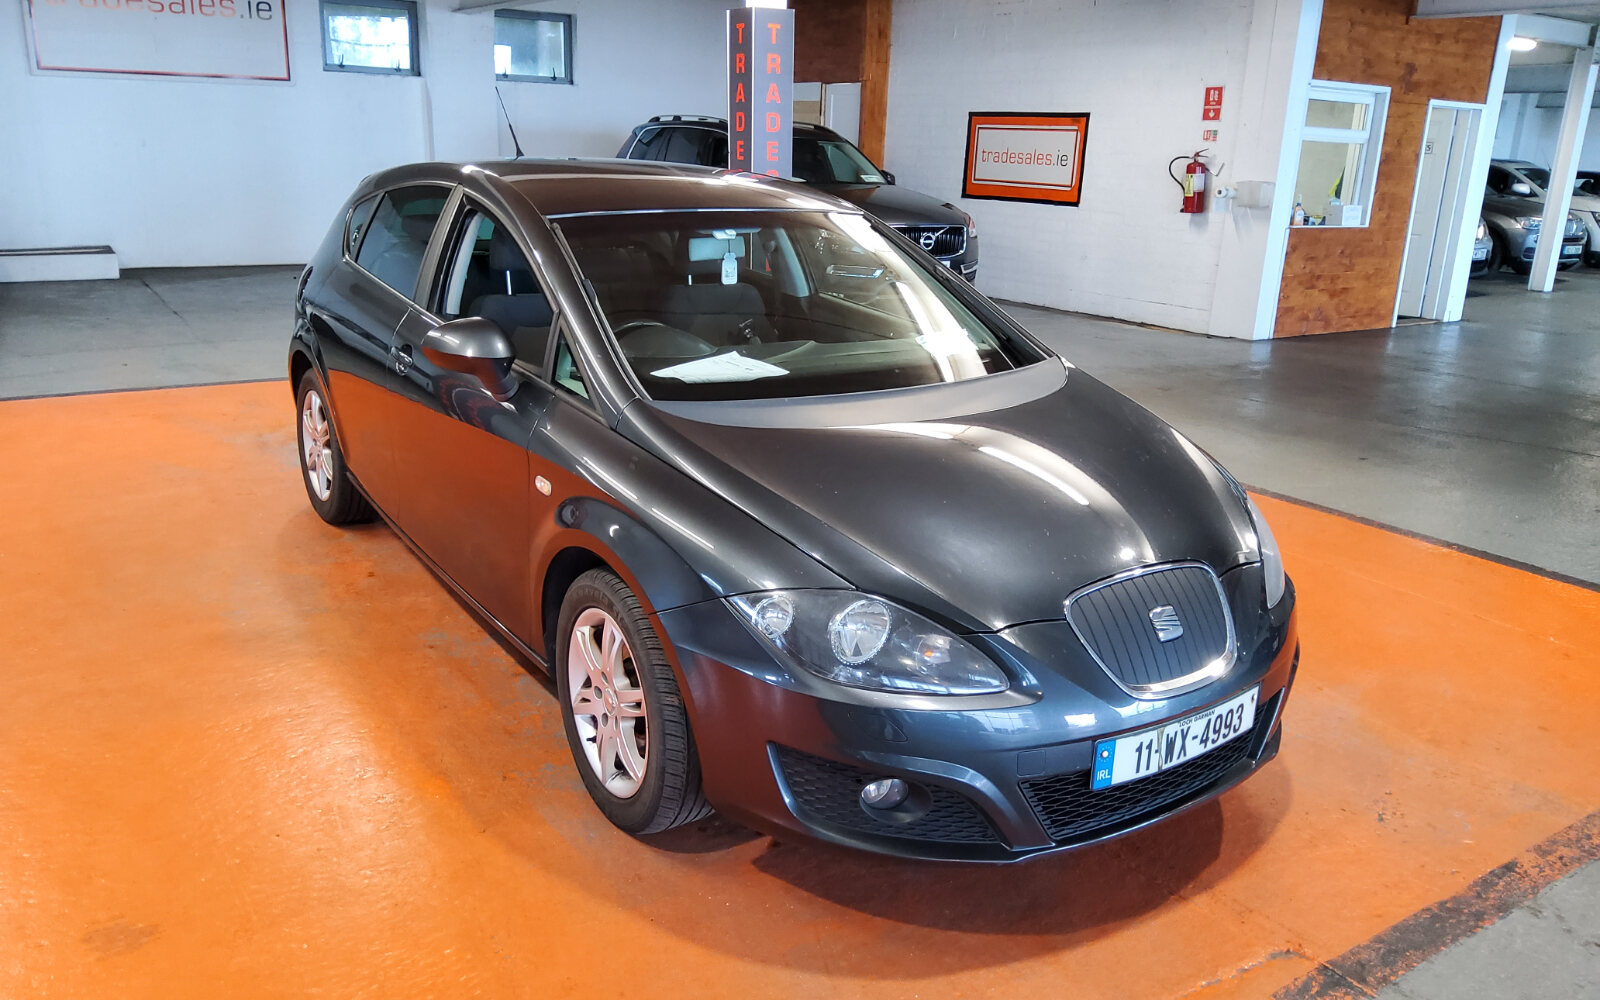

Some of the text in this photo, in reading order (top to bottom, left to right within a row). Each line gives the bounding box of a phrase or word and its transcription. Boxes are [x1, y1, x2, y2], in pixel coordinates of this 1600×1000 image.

[735, 22, 745, 172] TRADE
[981, 147, 1069, 167] tradesales.ie
[1135, 703, 1244, 773] 11-WX-4993
[1096, 769, 1111, 781] IRL
